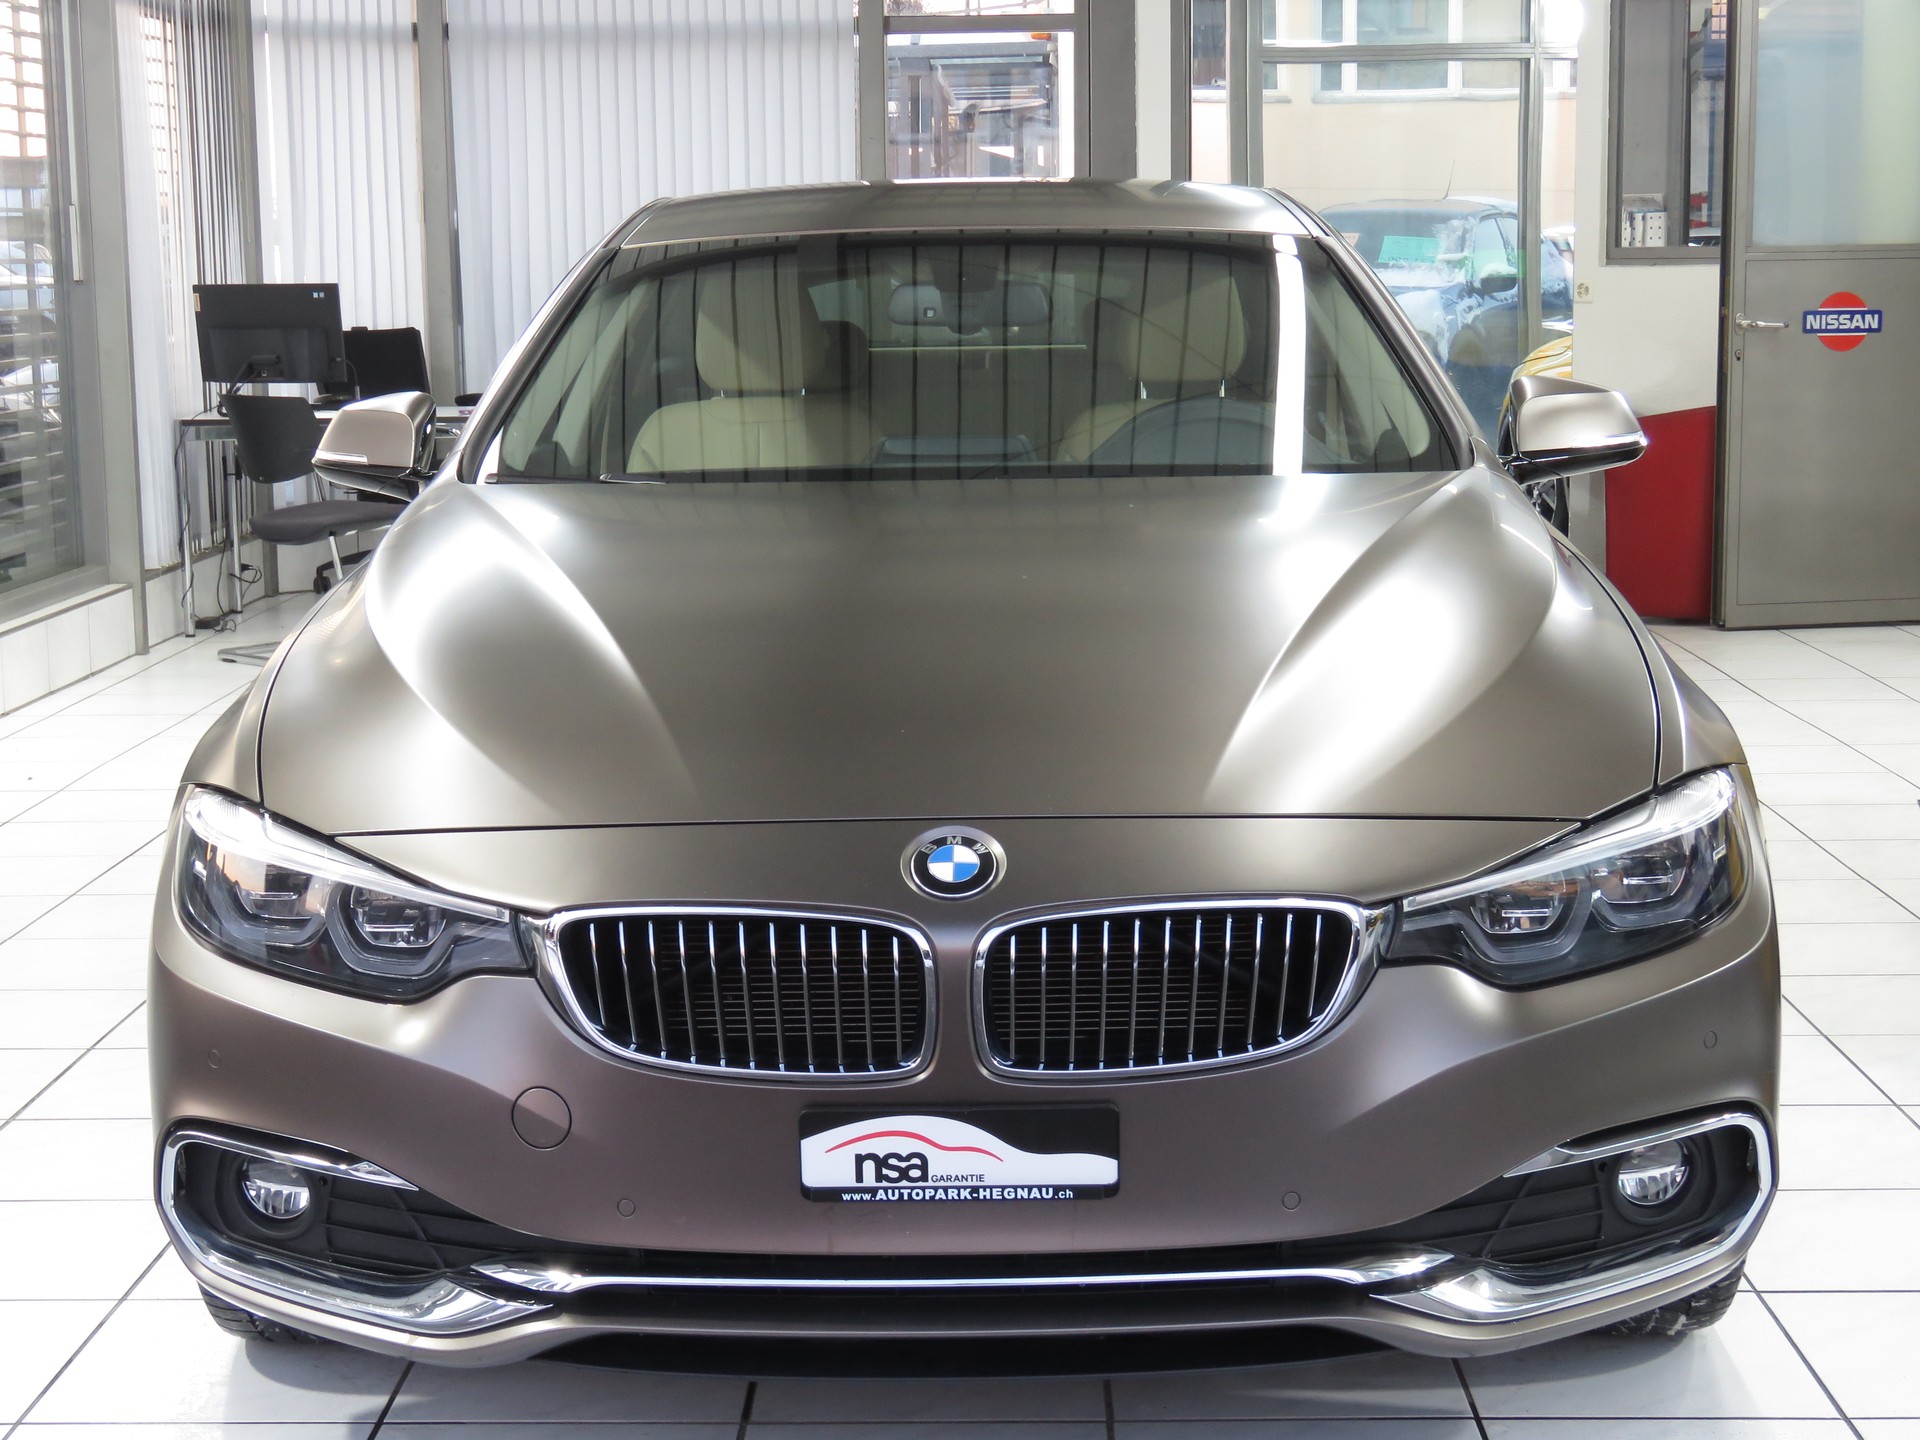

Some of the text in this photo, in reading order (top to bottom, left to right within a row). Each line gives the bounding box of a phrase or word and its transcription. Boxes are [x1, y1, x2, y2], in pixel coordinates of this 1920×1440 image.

[1806, 314, 1879, 330] NISSAN
[921, 836, 990, 854] BMW
[855, 1152, 985, 1183] nsa GARANTIE
[841, 1187, 1074, 1201] www.AUTOPARK-HEGNAU.ch
